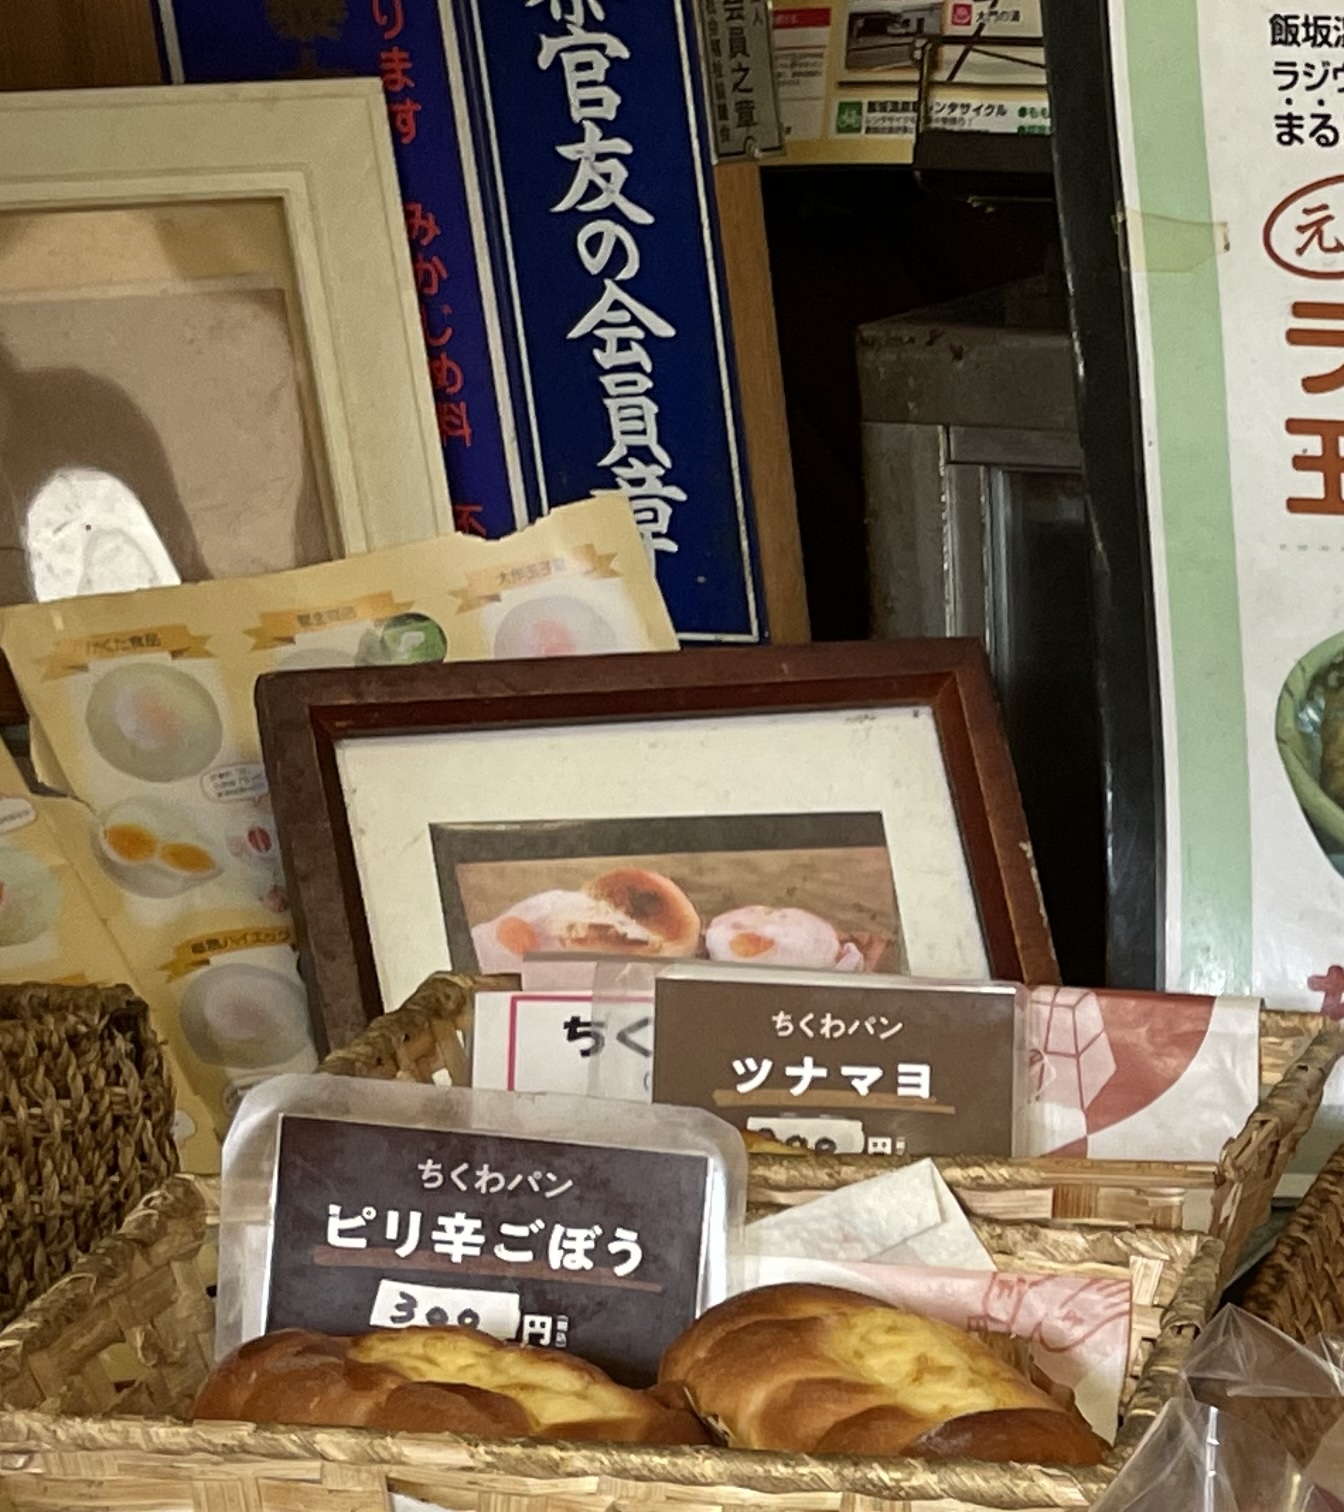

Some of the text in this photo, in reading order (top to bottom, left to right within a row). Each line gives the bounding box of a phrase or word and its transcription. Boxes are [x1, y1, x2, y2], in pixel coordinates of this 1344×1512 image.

[772, 1010, 903, 1041] ちくわパン
[732, 1054, 933, 1099] ツナマヨ
[417, 1158, 574, 1199] ちくわパン
[326, 1203, 644, 1277] ピリ辛ごぼう
